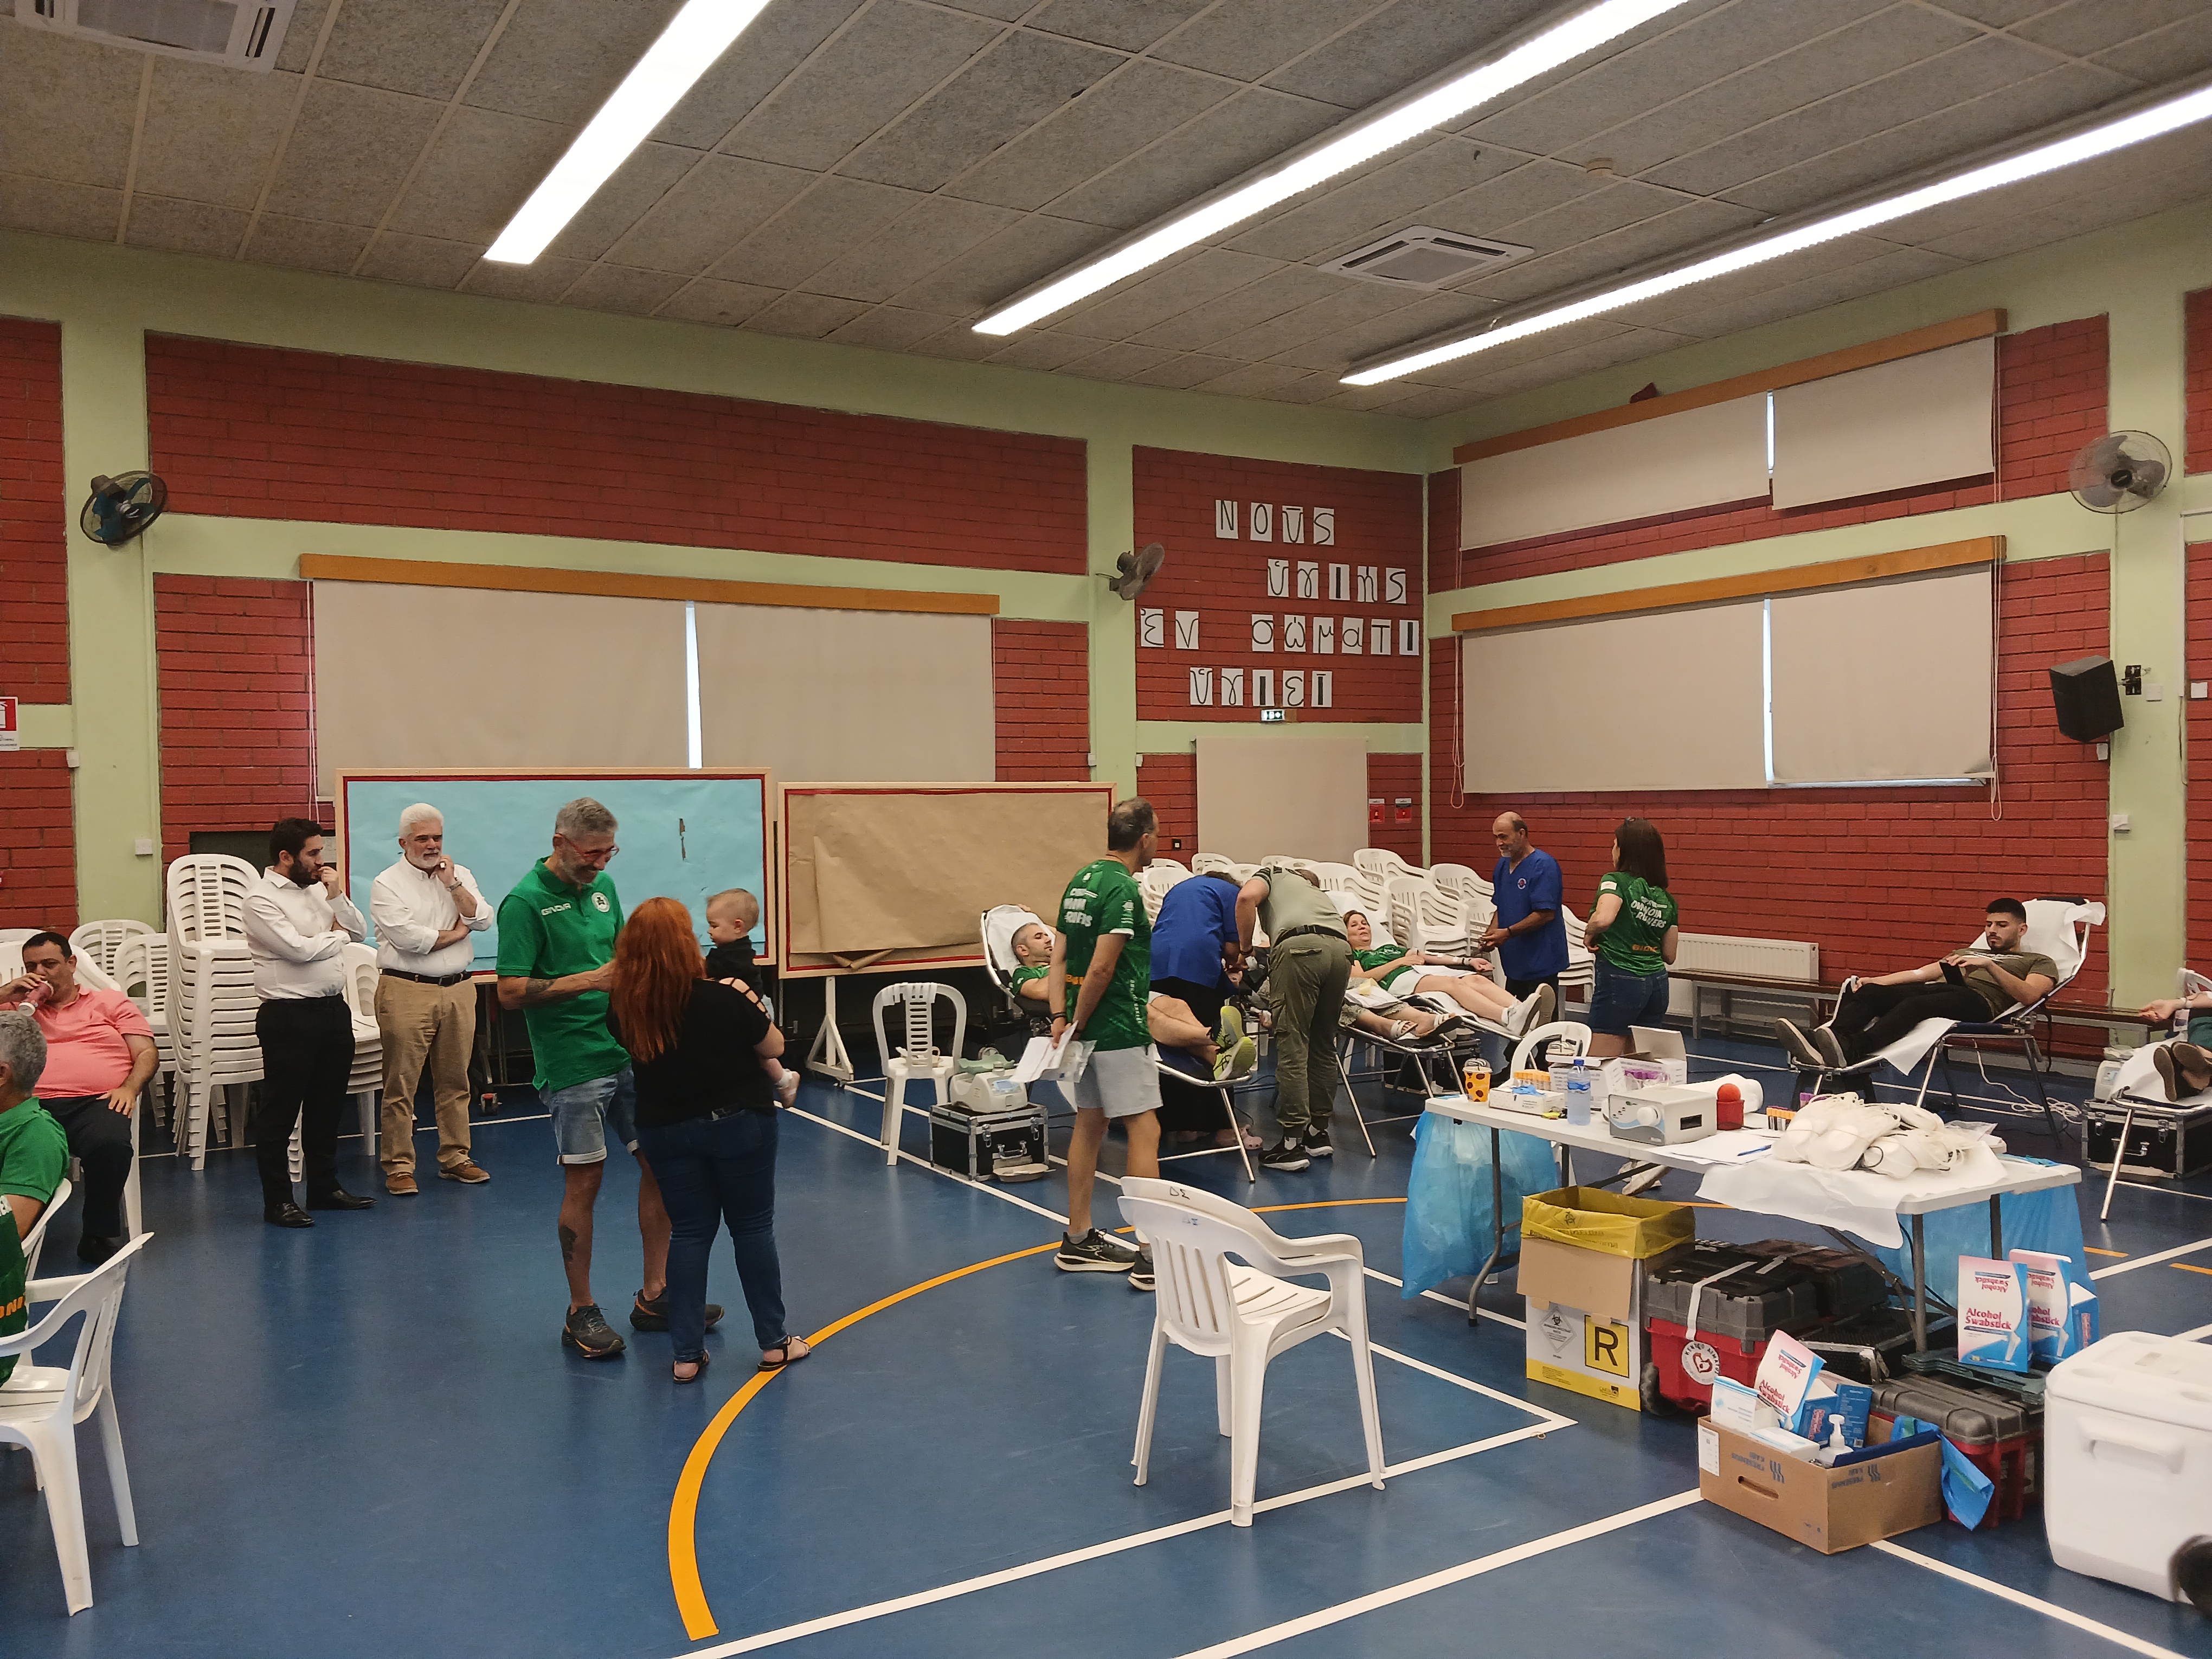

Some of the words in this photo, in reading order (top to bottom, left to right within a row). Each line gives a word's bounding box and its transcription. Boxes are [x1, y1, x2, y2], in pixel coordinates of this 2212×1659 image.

[1966, 1307, 2002, 1321] Alcohol
[2030, 1306, 2050, 1316] ohol
[1965, 1315, 2011, 1330] Swabstick
[2031, 1314, 2060, 1326] abstick
[1594, 1326, 1619, 1367] R
[1760, 1379, 1785, 1401] Alcohol
[1759, 1385, 1790, 1414] Swabstick
